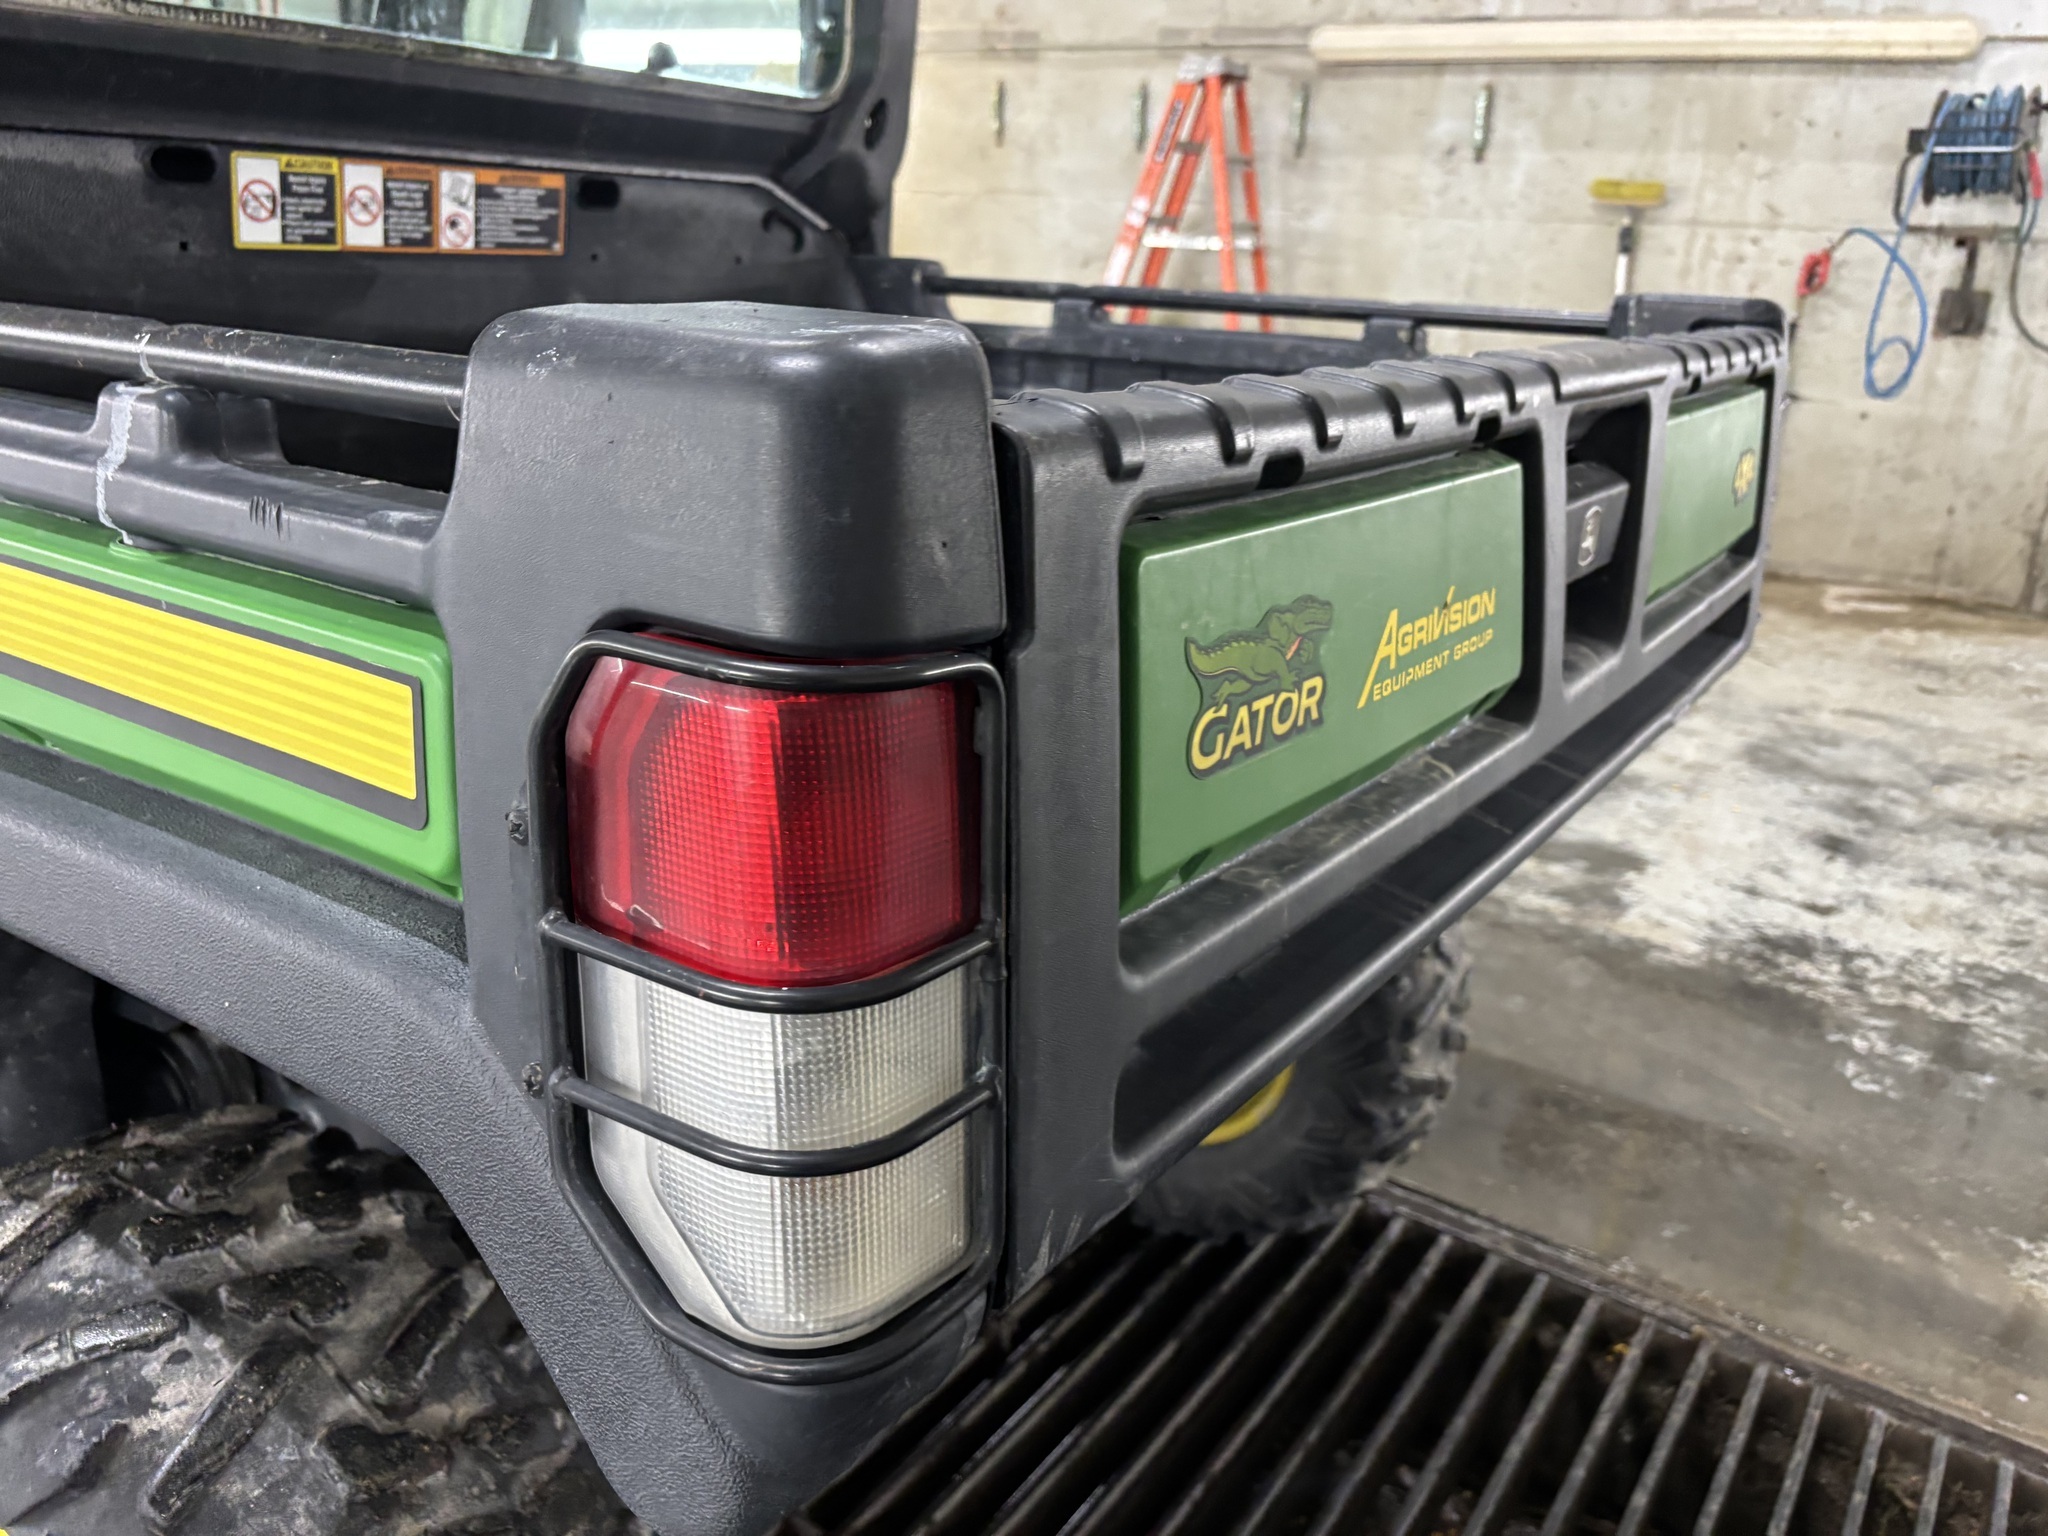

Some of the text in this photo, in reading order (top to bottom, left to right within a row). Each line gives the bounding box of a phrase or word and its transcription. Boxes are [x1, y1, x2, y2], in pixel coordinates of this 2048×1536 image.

[1357, 585, 1497, 709] AGRIVISION
[1373, 628, 1494, 702] EQUIPMENT GROUP
[1191, 676, 1324, 770] GATOR
